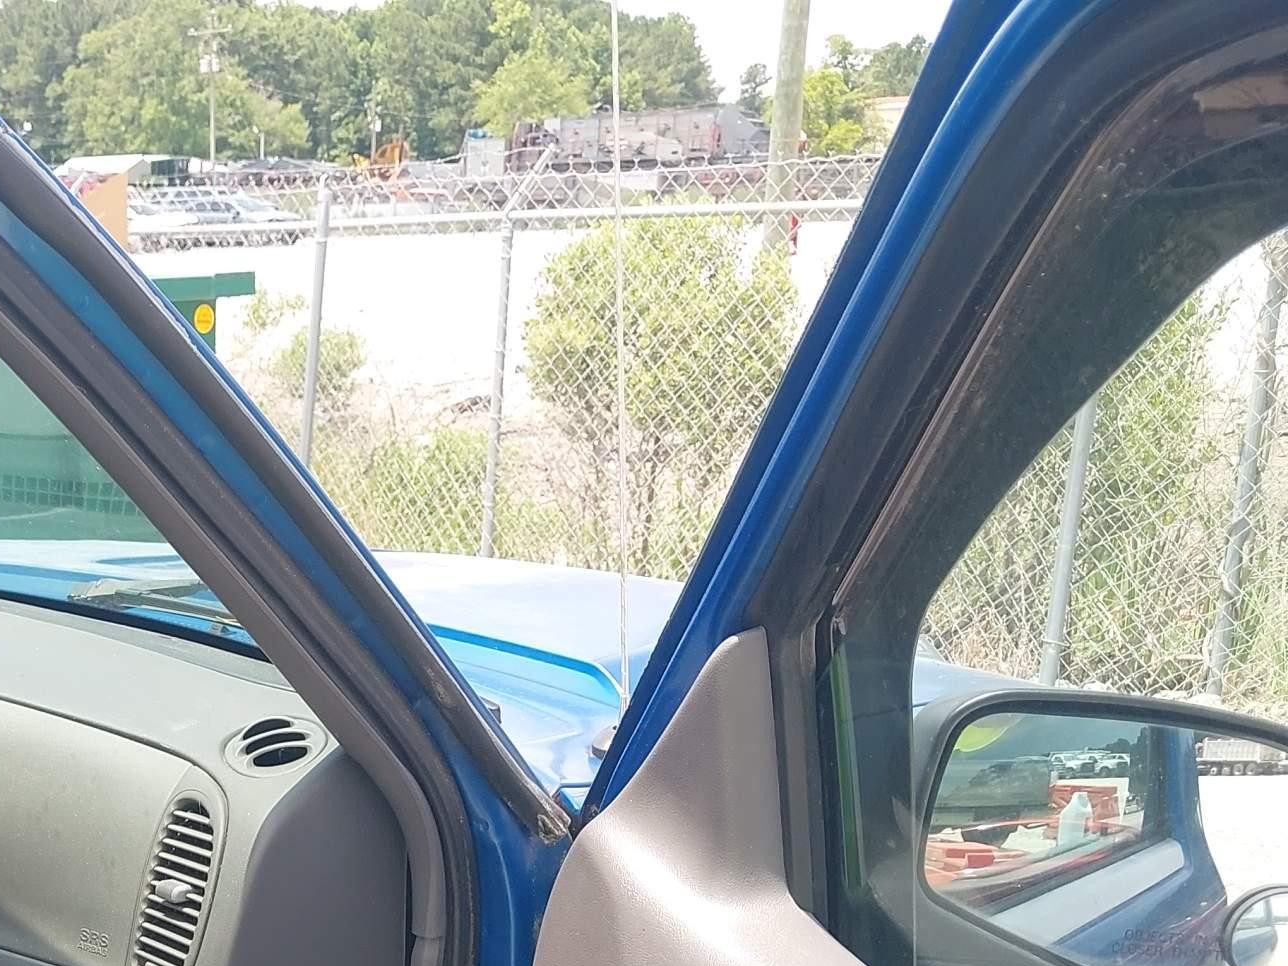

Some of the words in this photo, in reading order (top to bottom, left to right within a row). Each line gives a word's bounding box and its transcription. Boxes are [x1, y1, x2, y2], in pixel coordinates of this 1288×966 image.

[79, 926, 110, 948] SRS
[1123, 928, 1184, 946] OBJECTS
[1111, 942, 1164, 958] CLOSER
